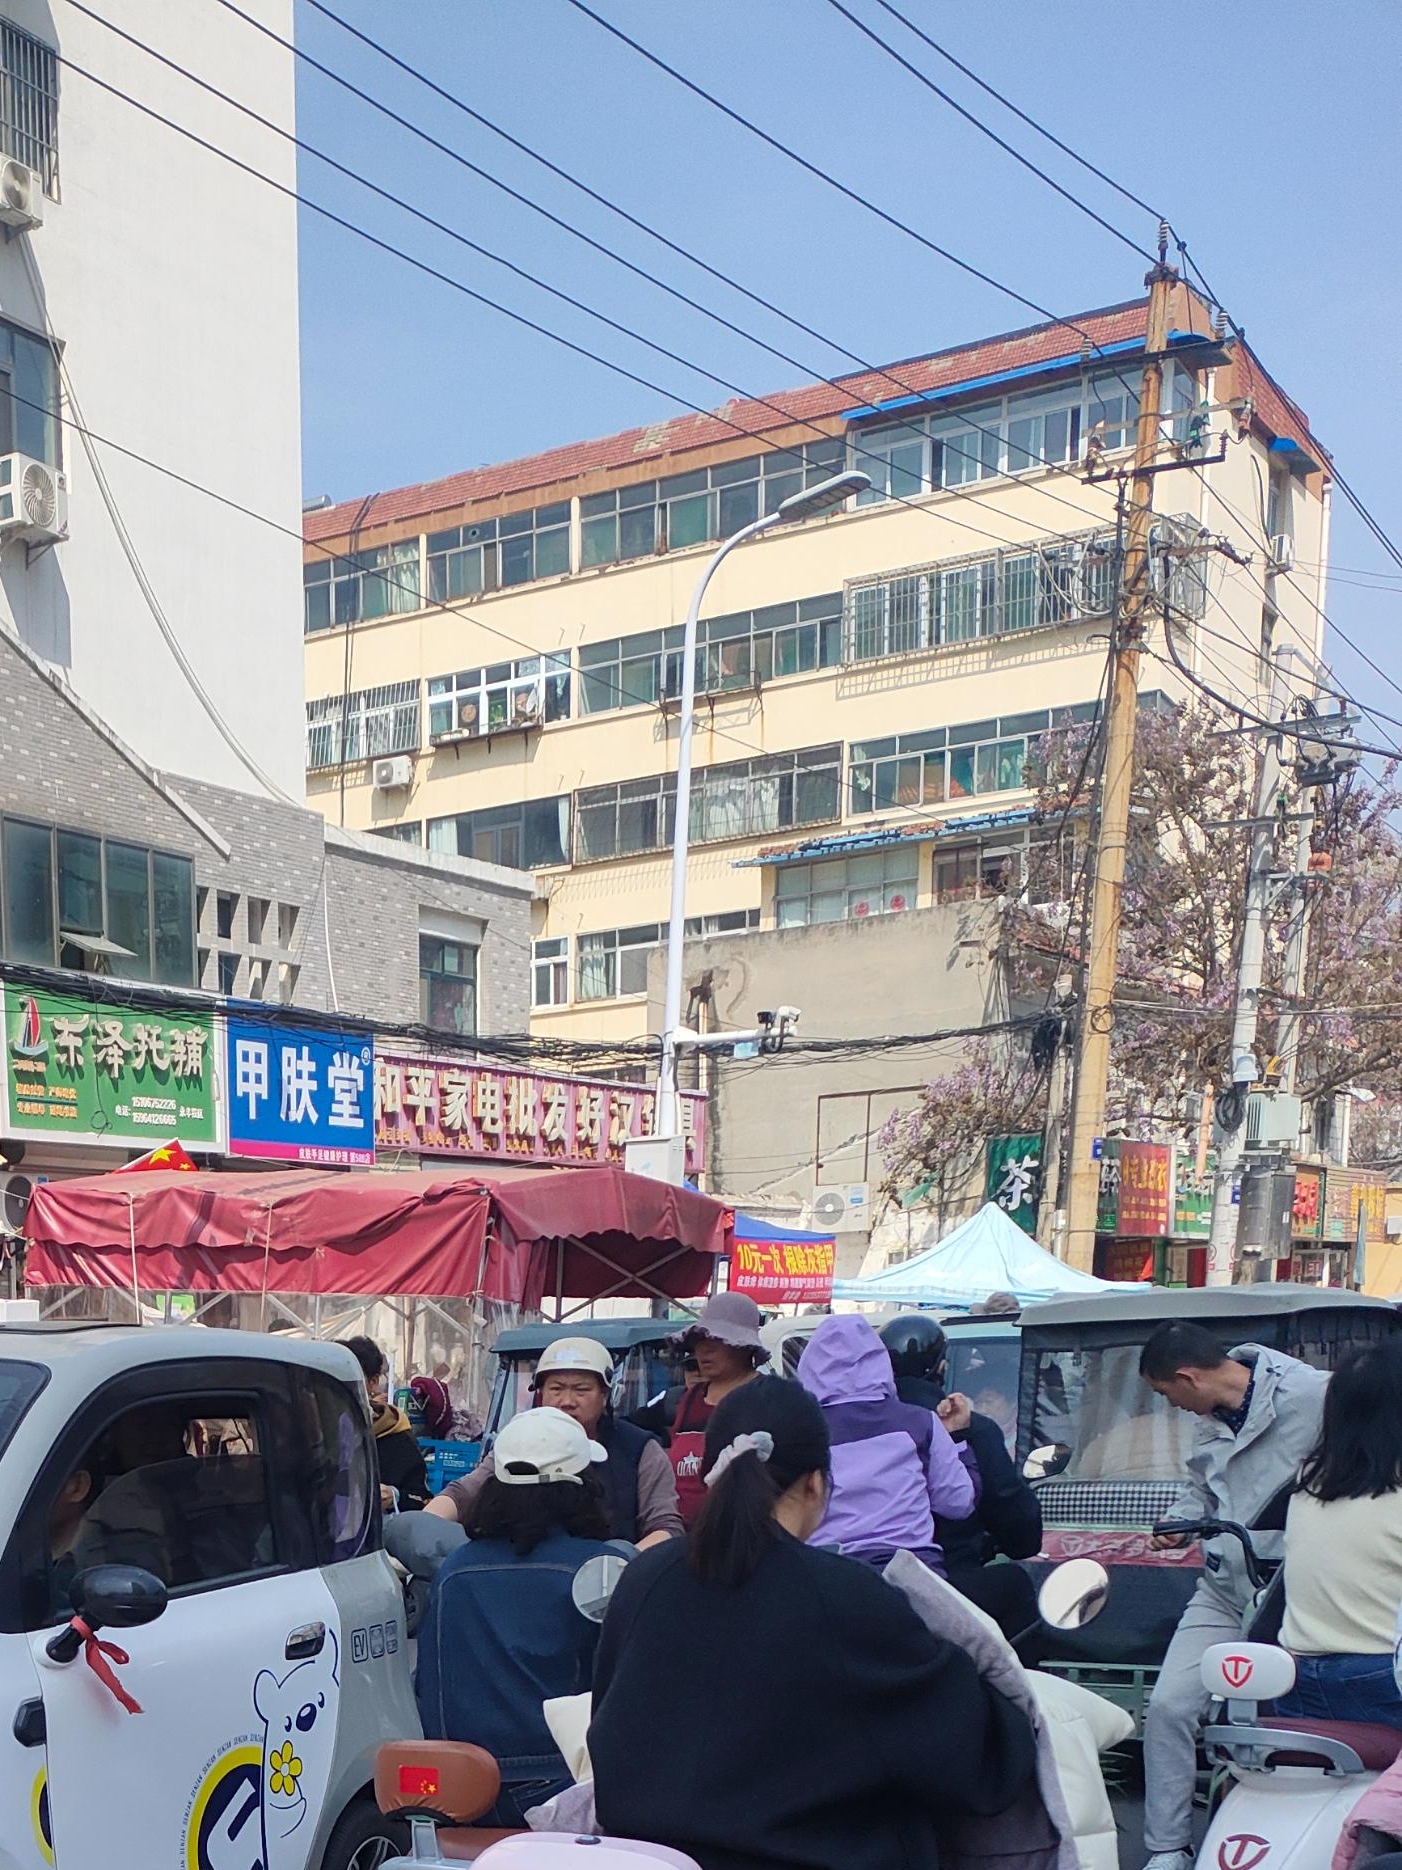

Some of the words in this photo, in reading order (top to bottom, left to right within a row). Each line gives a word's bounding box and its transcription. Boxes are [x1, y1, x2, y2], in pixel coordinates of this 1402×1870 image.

[236, 1038, 365, 1129] 甲肤堂
[999, 1153, 1040, 1211] 茶
